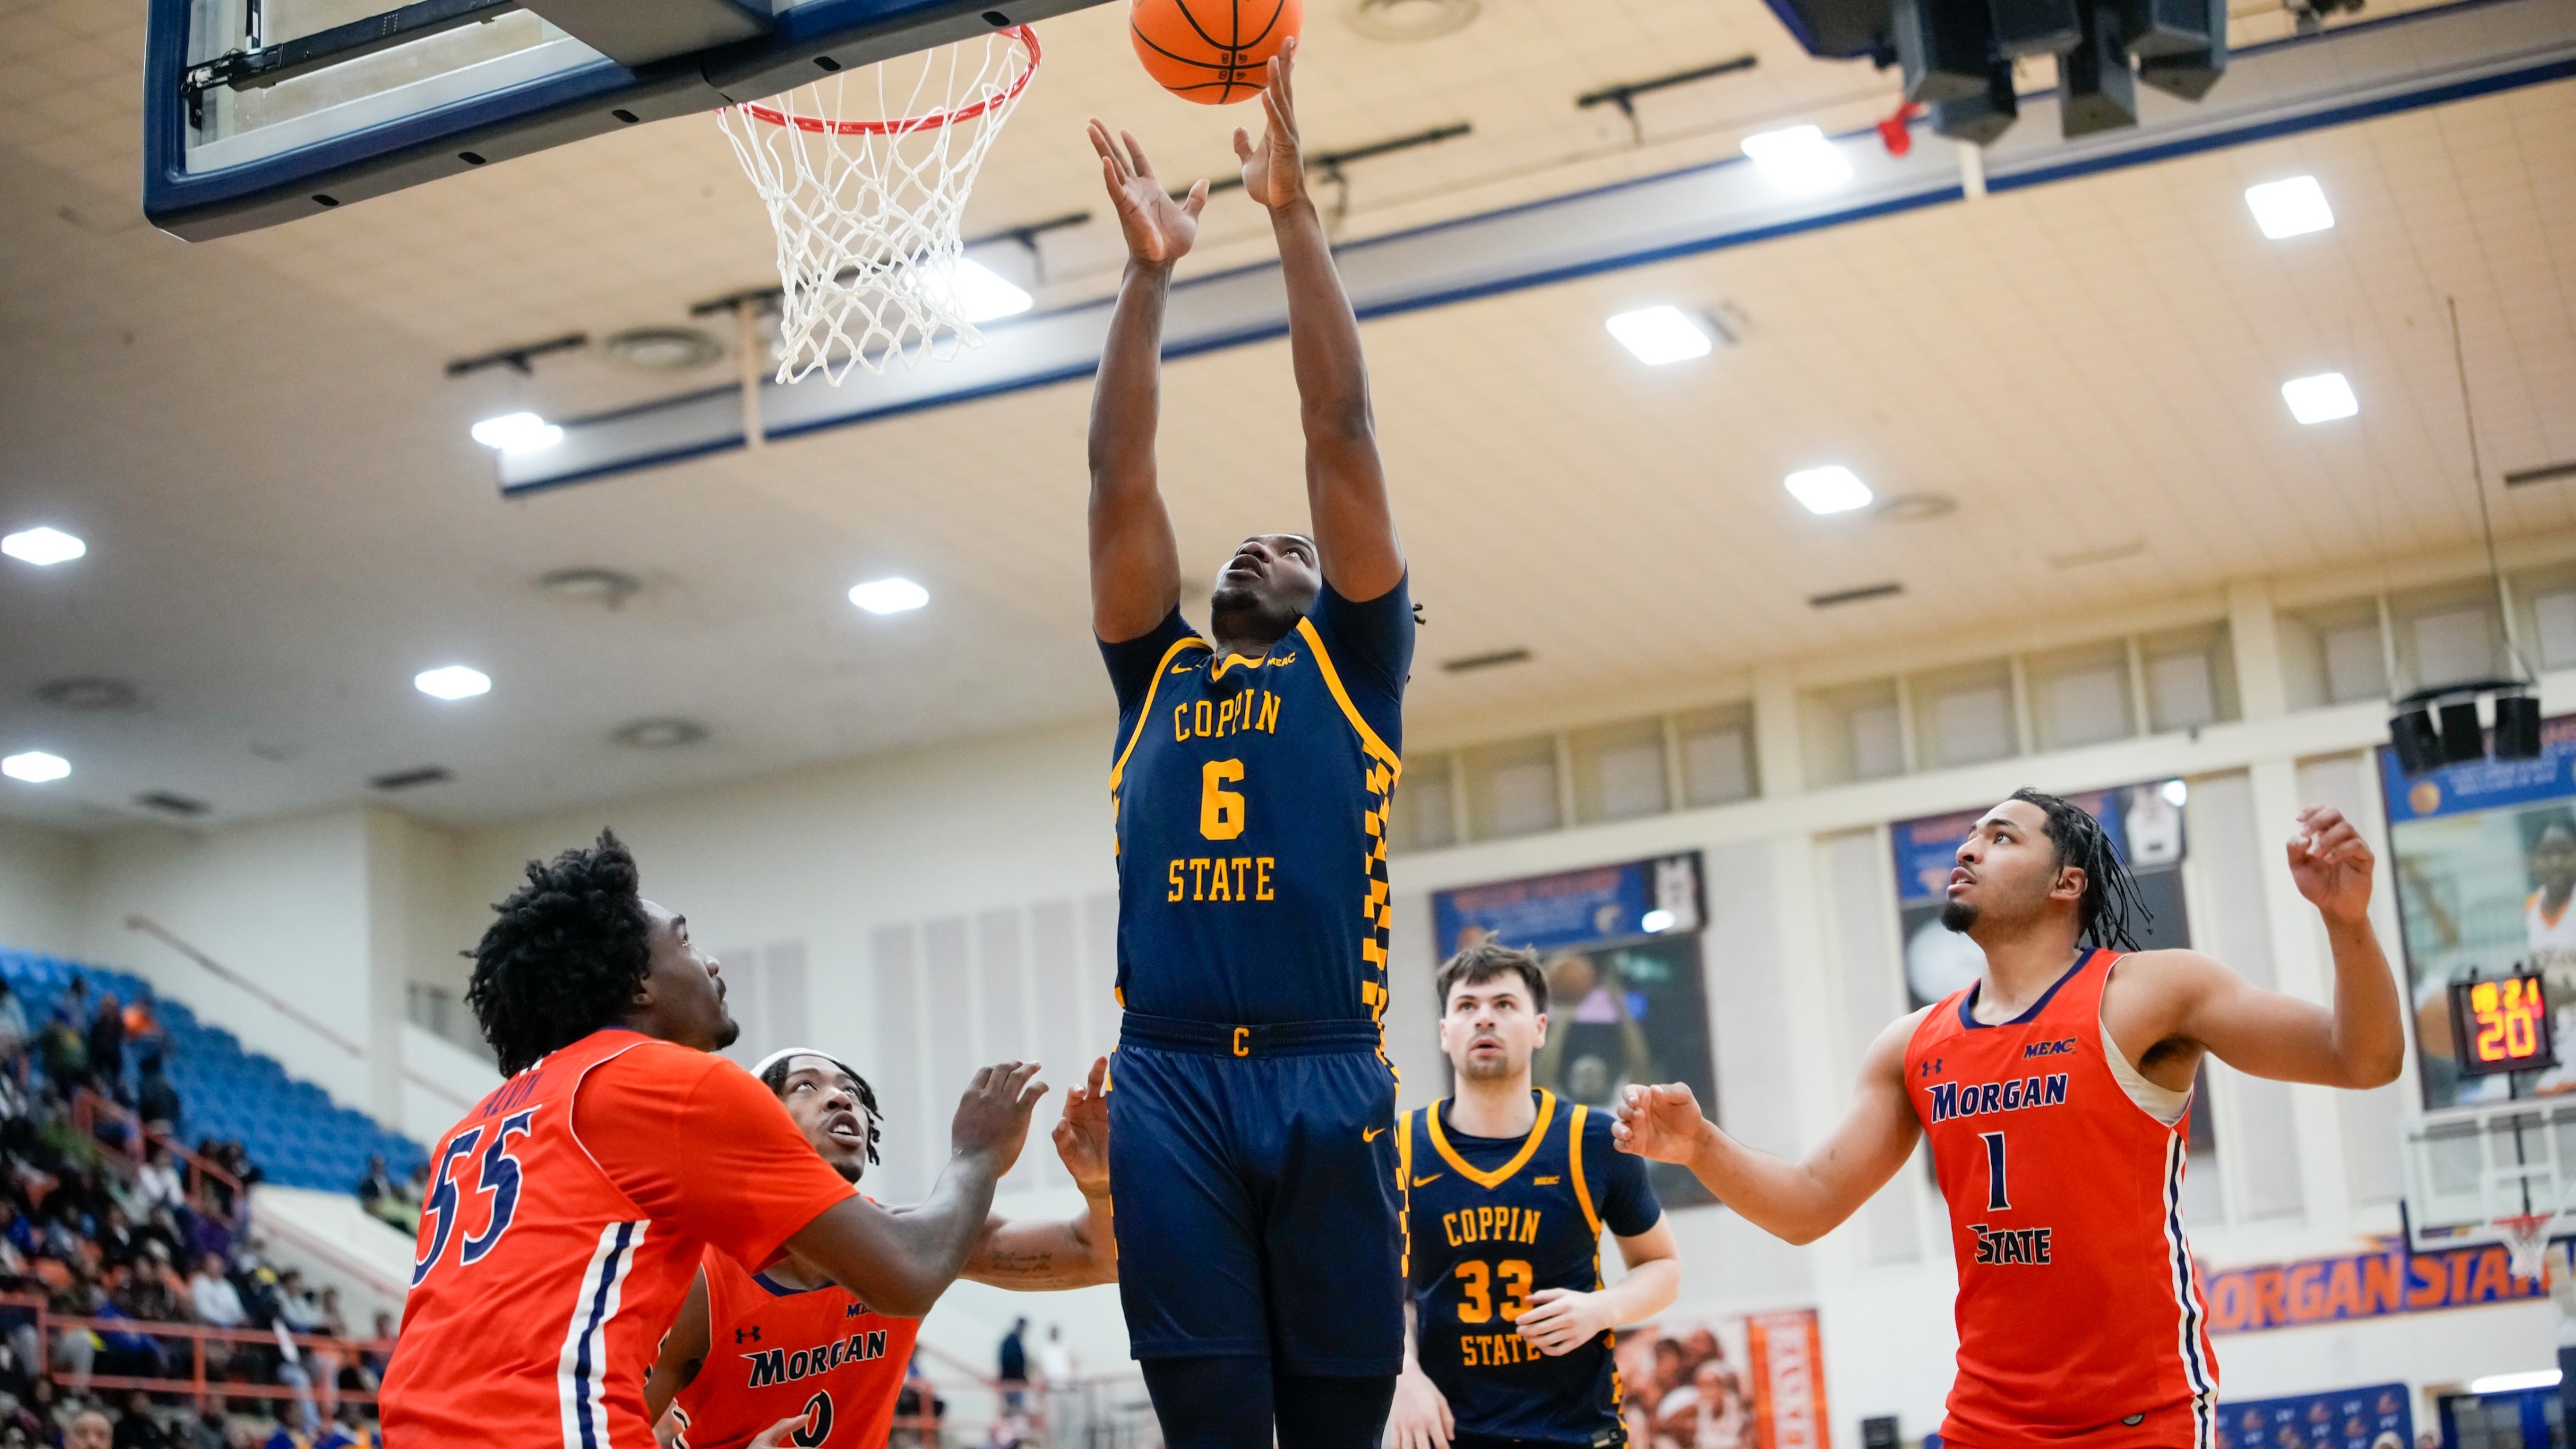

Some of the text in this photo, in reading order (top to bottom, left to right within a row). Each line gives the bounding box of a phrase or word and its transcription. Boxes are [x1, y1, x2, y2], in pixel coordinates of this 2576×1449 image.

[1266, 651, 1296, 667] MEAC
[1174, 688, 1281, 743] COPPIN
[1199, 758, 1245, 840] 6
[1168, 857, 1275, 902] STATE
[1233, 1027, 1249, 1057] C
[2022, 1036, 2078, 1062] MEAC
[2476, 1006, 2537, 1062] 20
[1924, 1072, 2069, 1124] MORGAN
[410, 1103, 543, 1290] 55
[1977, 1130, 2012, 1212] 1
[1443, 1206, 1541, 1247] COPPIN
[1965, 1223, 2052, 1266] STATE
[1454, 1259, 1535, 1324] 33
[739, 1329, 887, 1389] MORGAN
[790, 1388, 835, 1448] 0
